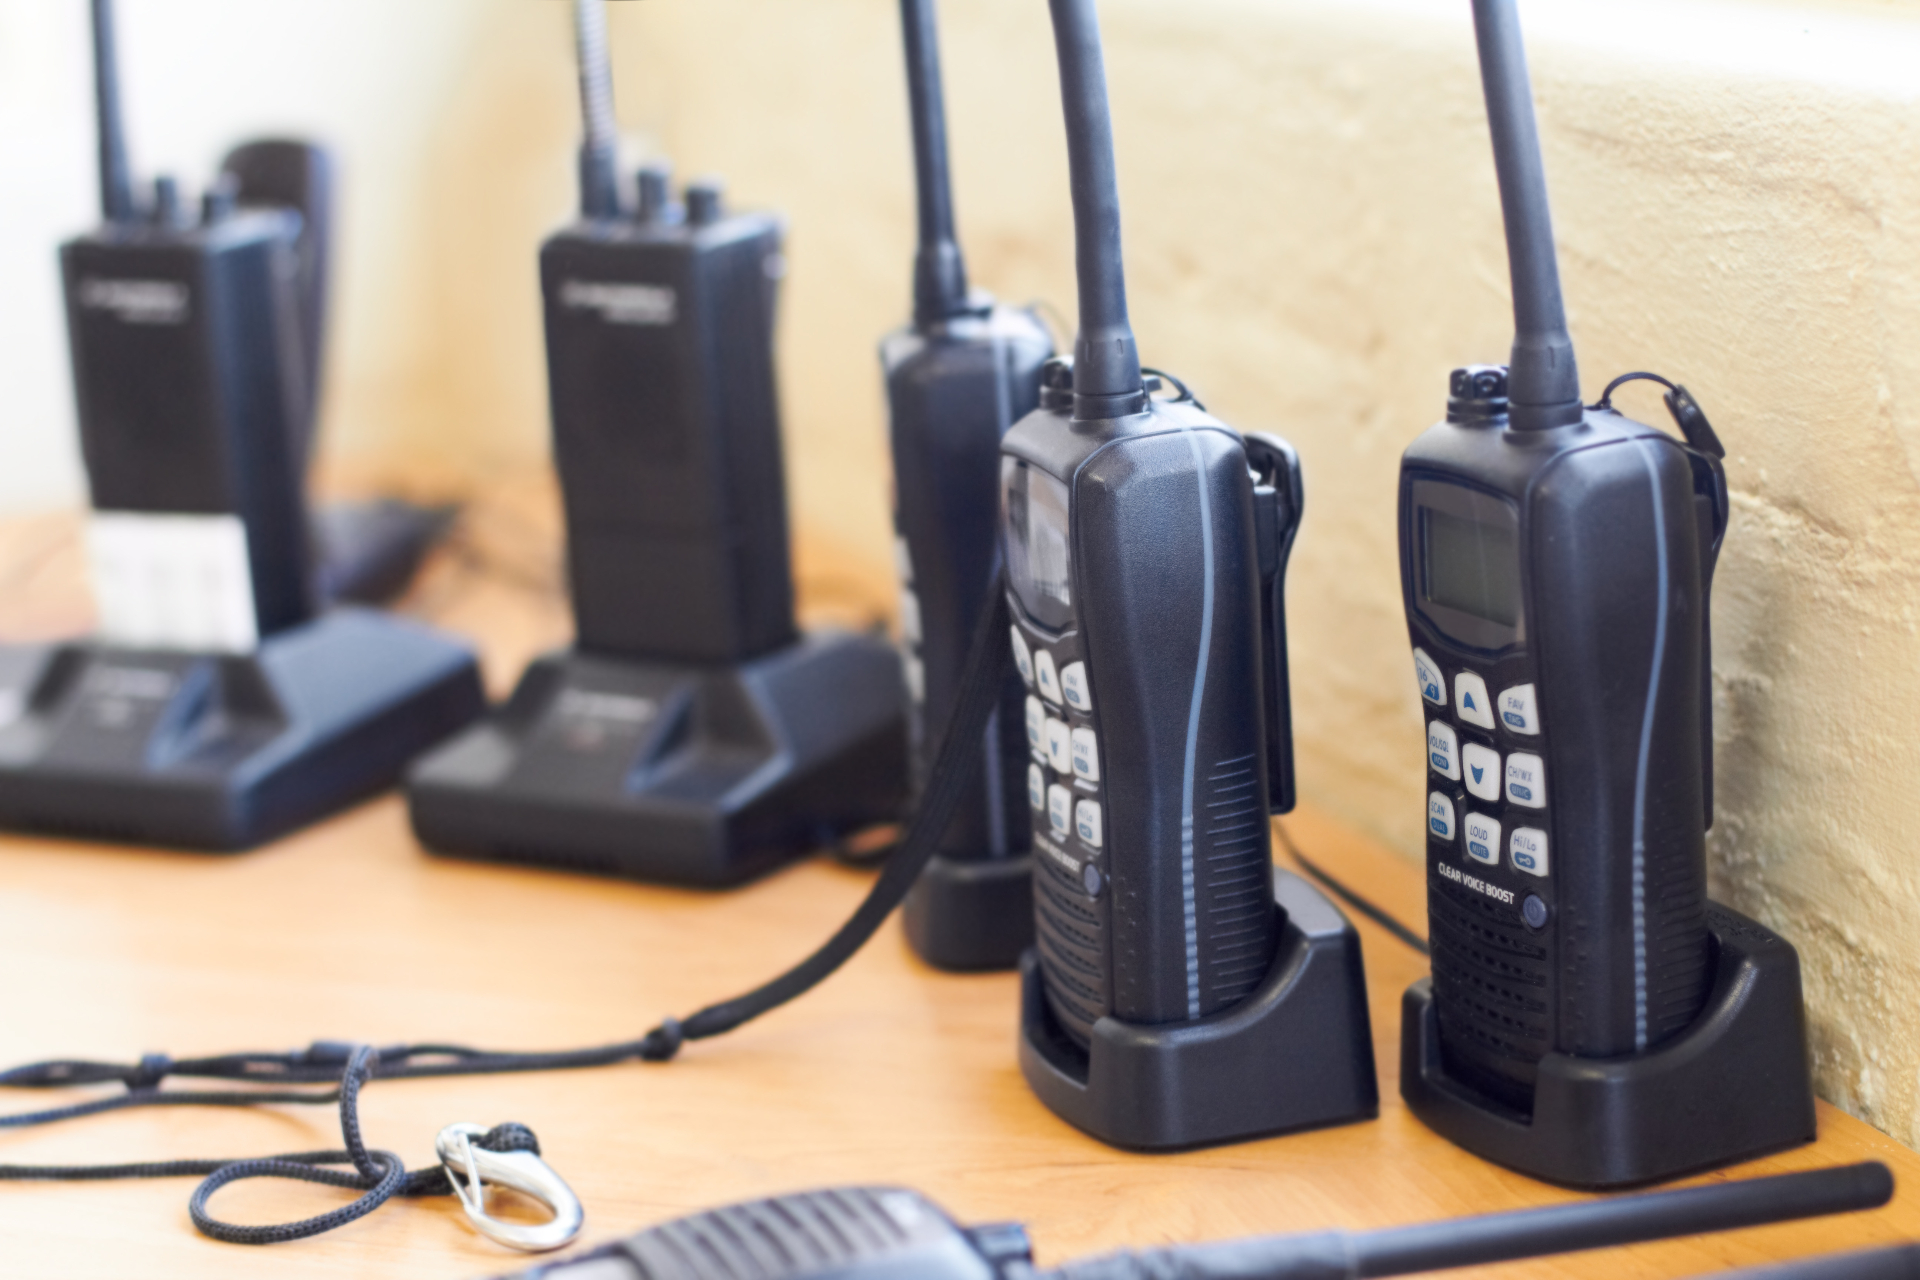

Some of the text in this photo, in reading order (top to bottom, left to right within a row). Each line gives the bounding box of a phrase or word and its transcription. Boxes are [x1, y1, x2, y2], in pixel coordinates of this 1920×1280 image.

[1507, 696, 1524, 711] FAV
[1508, 765, 1532, 782] CH/WX
[1430, 800, 1445, 817] SCAN
[1470, 824, 1488, 840] LOUD
[1472, 843, 1487, 857] MUTE
[1514, 834, 1536, 851] Hi/Lo
[1438, 862, 1515, 905] CLEAR VOICE BOOST
